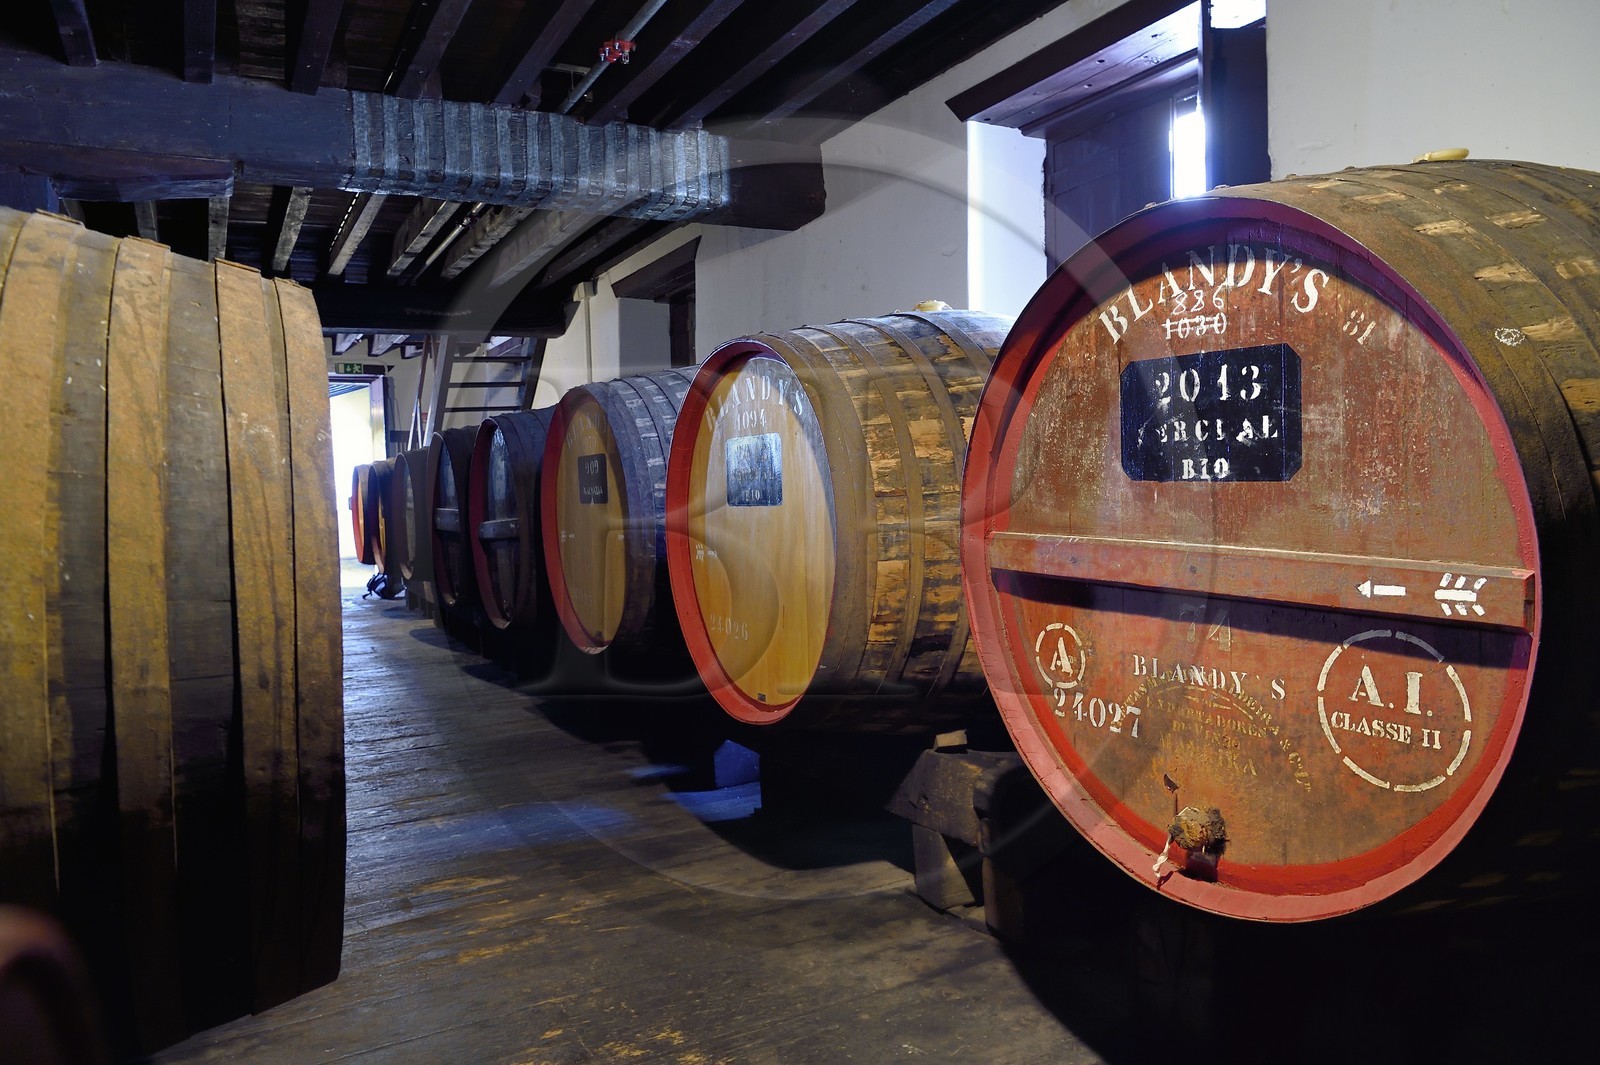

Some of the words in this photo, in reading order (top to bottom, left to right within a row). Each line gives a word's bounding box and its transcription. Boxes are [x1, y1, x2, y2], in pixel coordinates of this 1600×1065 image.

[1155, 363, 1263, 404] 2013
[1137, 415, 1279, 447] ERCIAL
[1181, 457, 1231, 480] BIO
[1050, 636, 1074, 676] A
[1053, 688, 1142, 739] 24027
[1330, 711, 1412, 745] CLASSE
[1420, 727, 1443, 750] II
